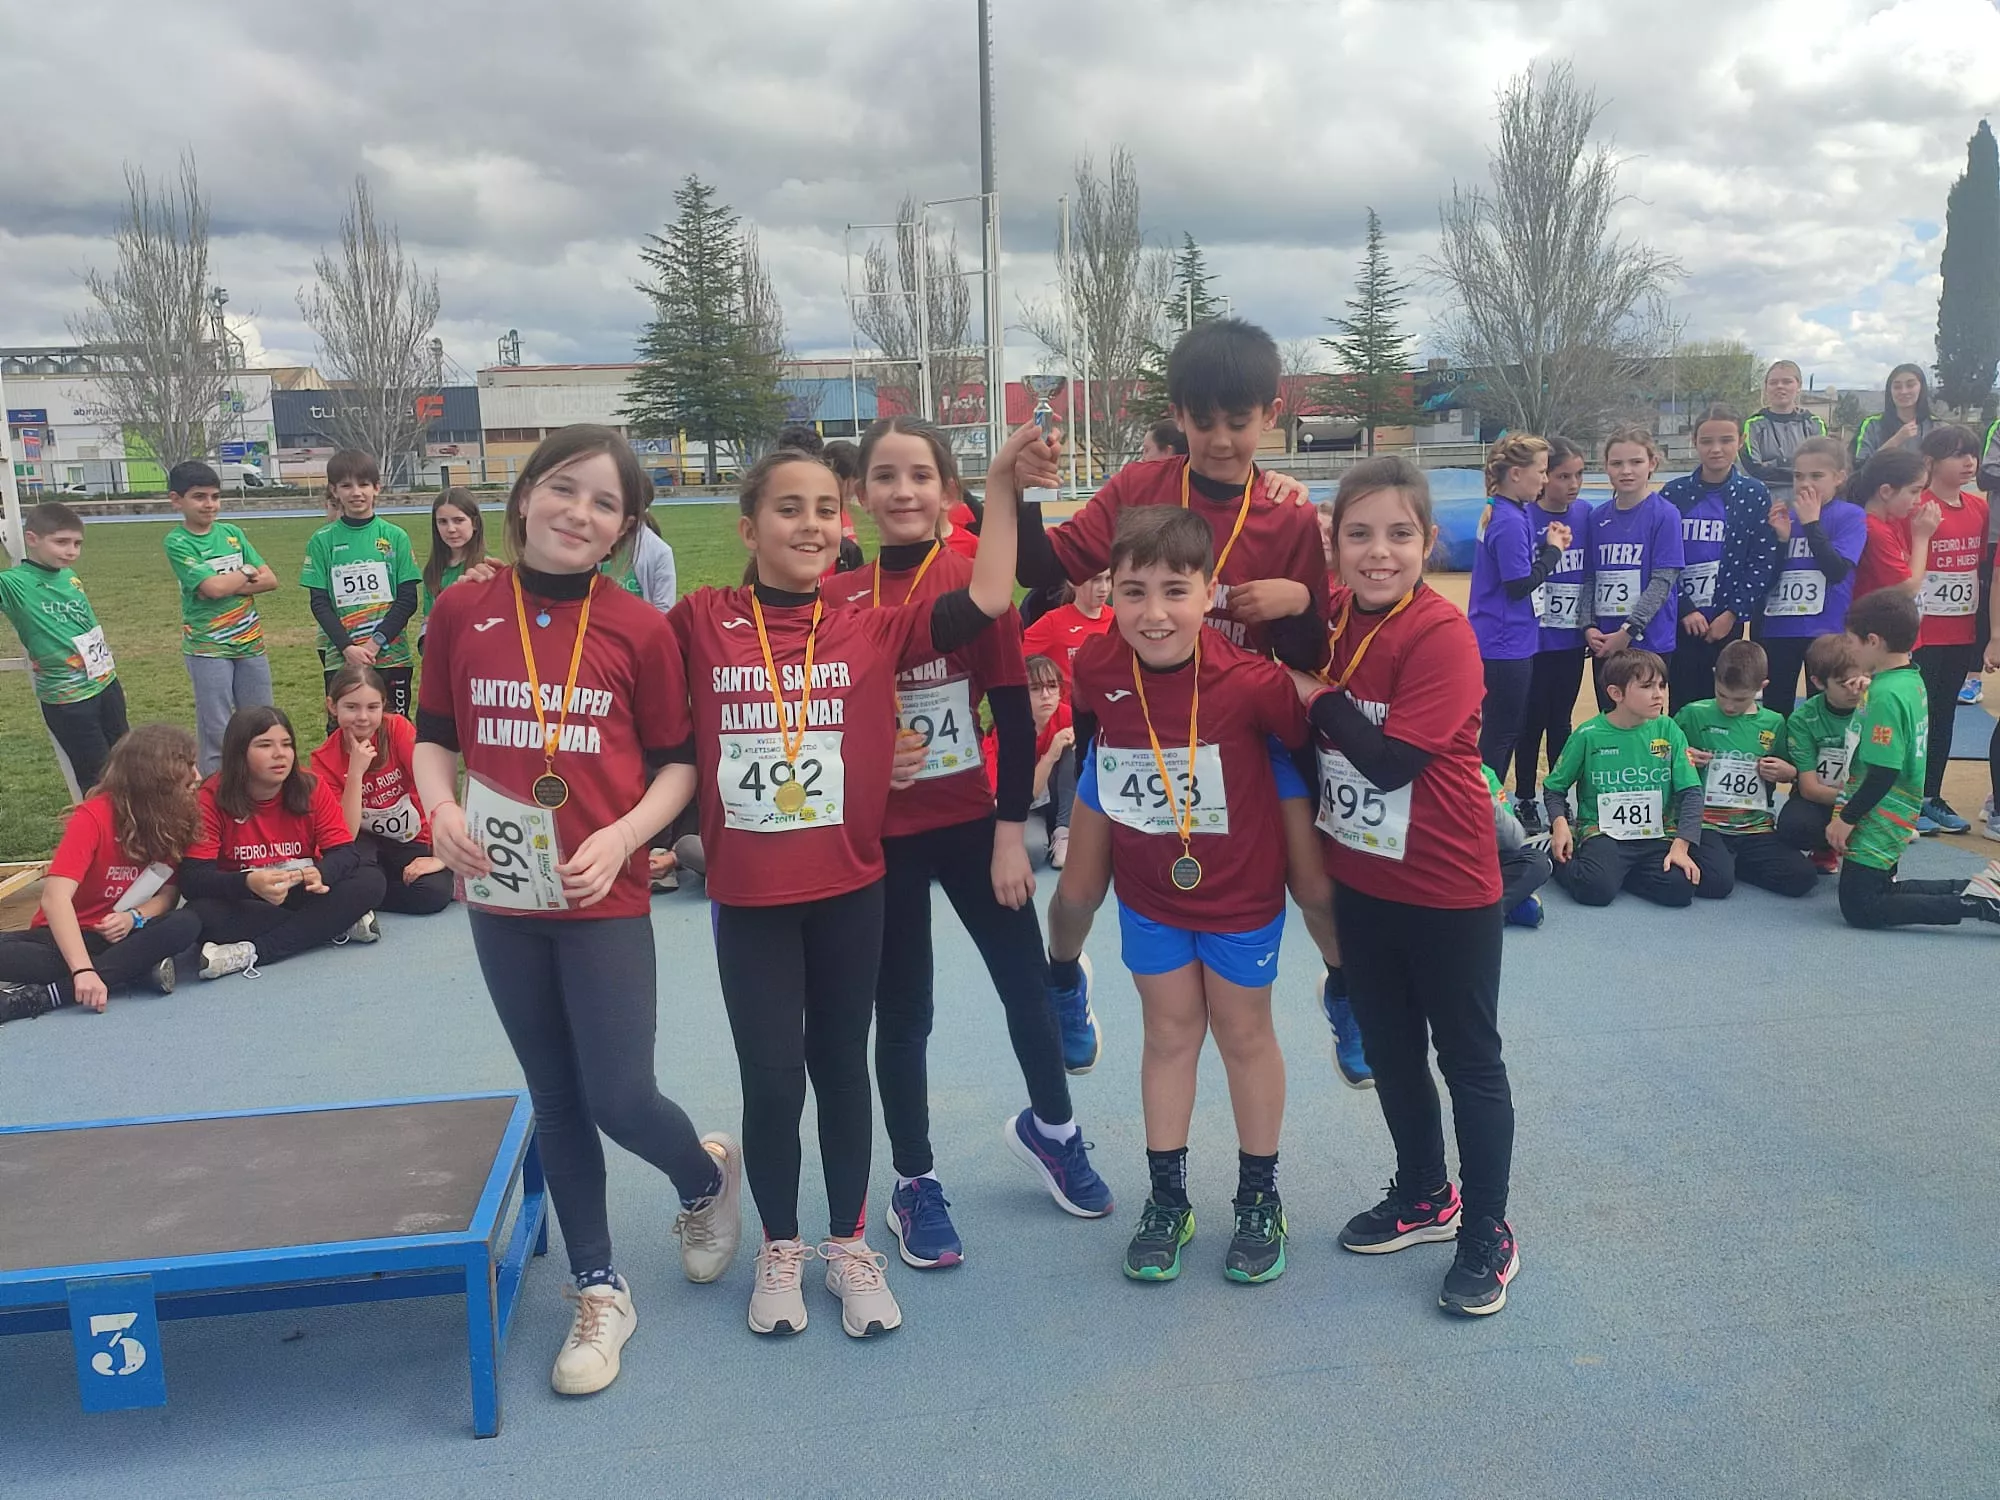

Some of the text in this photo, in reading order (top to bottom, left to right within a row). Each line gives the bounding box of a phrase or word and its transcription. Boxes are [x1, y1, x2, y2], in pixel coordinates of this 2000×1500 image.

[1681, 519, 1726, 542] TIER
[1599, 543, 1644, 566] TIERZ
[343, 573, 380, 594] 518
[1934, 583, 1973, 602] 403
[711, 661, 851, 693] SANTOS SAMPER
[470, 677, 614, 718] SANTOS SAMPER
[896, 708, 959, 748] 94
[738, 759, 823, 802] 492
[1119, 773, 1202, 809] 493
[1718, 772, 1759, 795] 486
[1323, 777, 1388, 827] 495
[1612, 804, 1652, 825] 481
[234, 844, 267, 860] PEDRO
[486, 816, 530, 893] 498
[105, 866, 140, 881] PEDRO
[89, 1312, 147, 1376] 3
